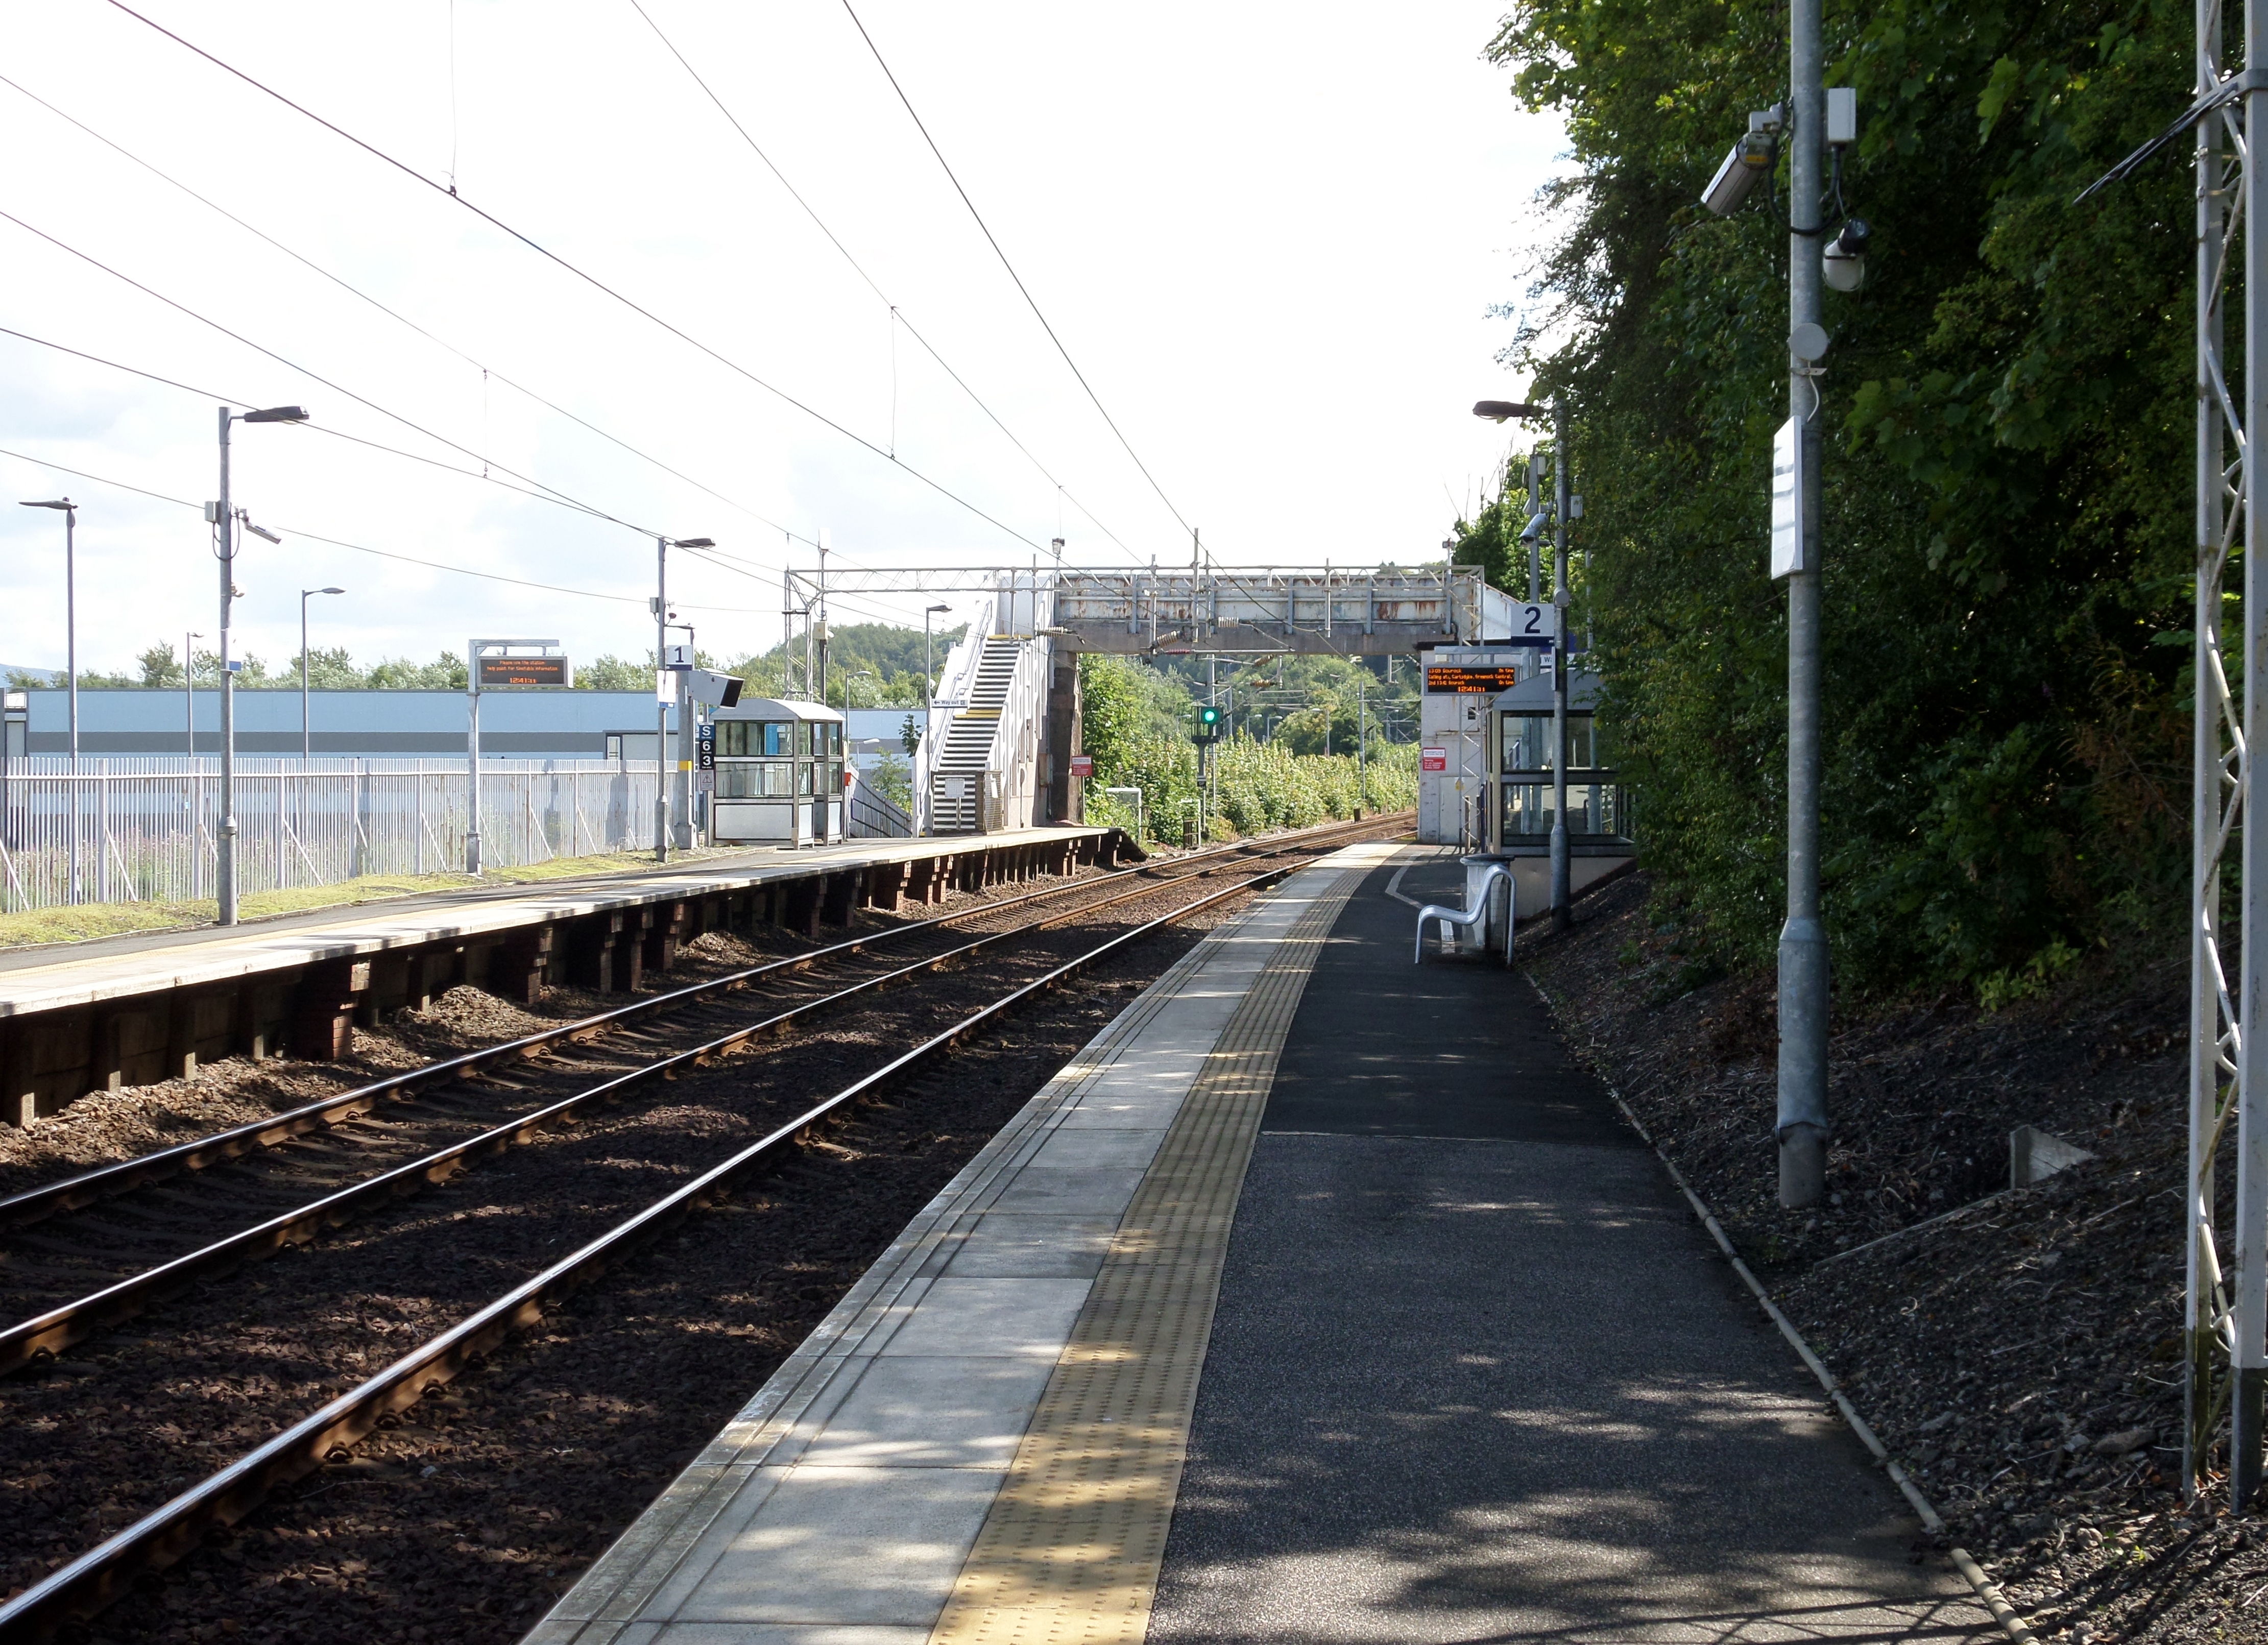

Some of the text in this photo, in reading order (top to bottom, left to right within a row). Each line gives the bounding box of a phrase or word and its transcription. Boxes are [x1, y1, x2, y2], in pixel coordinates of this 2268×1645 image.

[1524, 606, 1541, 634] 2
[674, 645, 685, 663] 1
[702, 725, 711, 736] S
[703, 741, 711, 751] 6
[703, 756, 711, 766] 3
